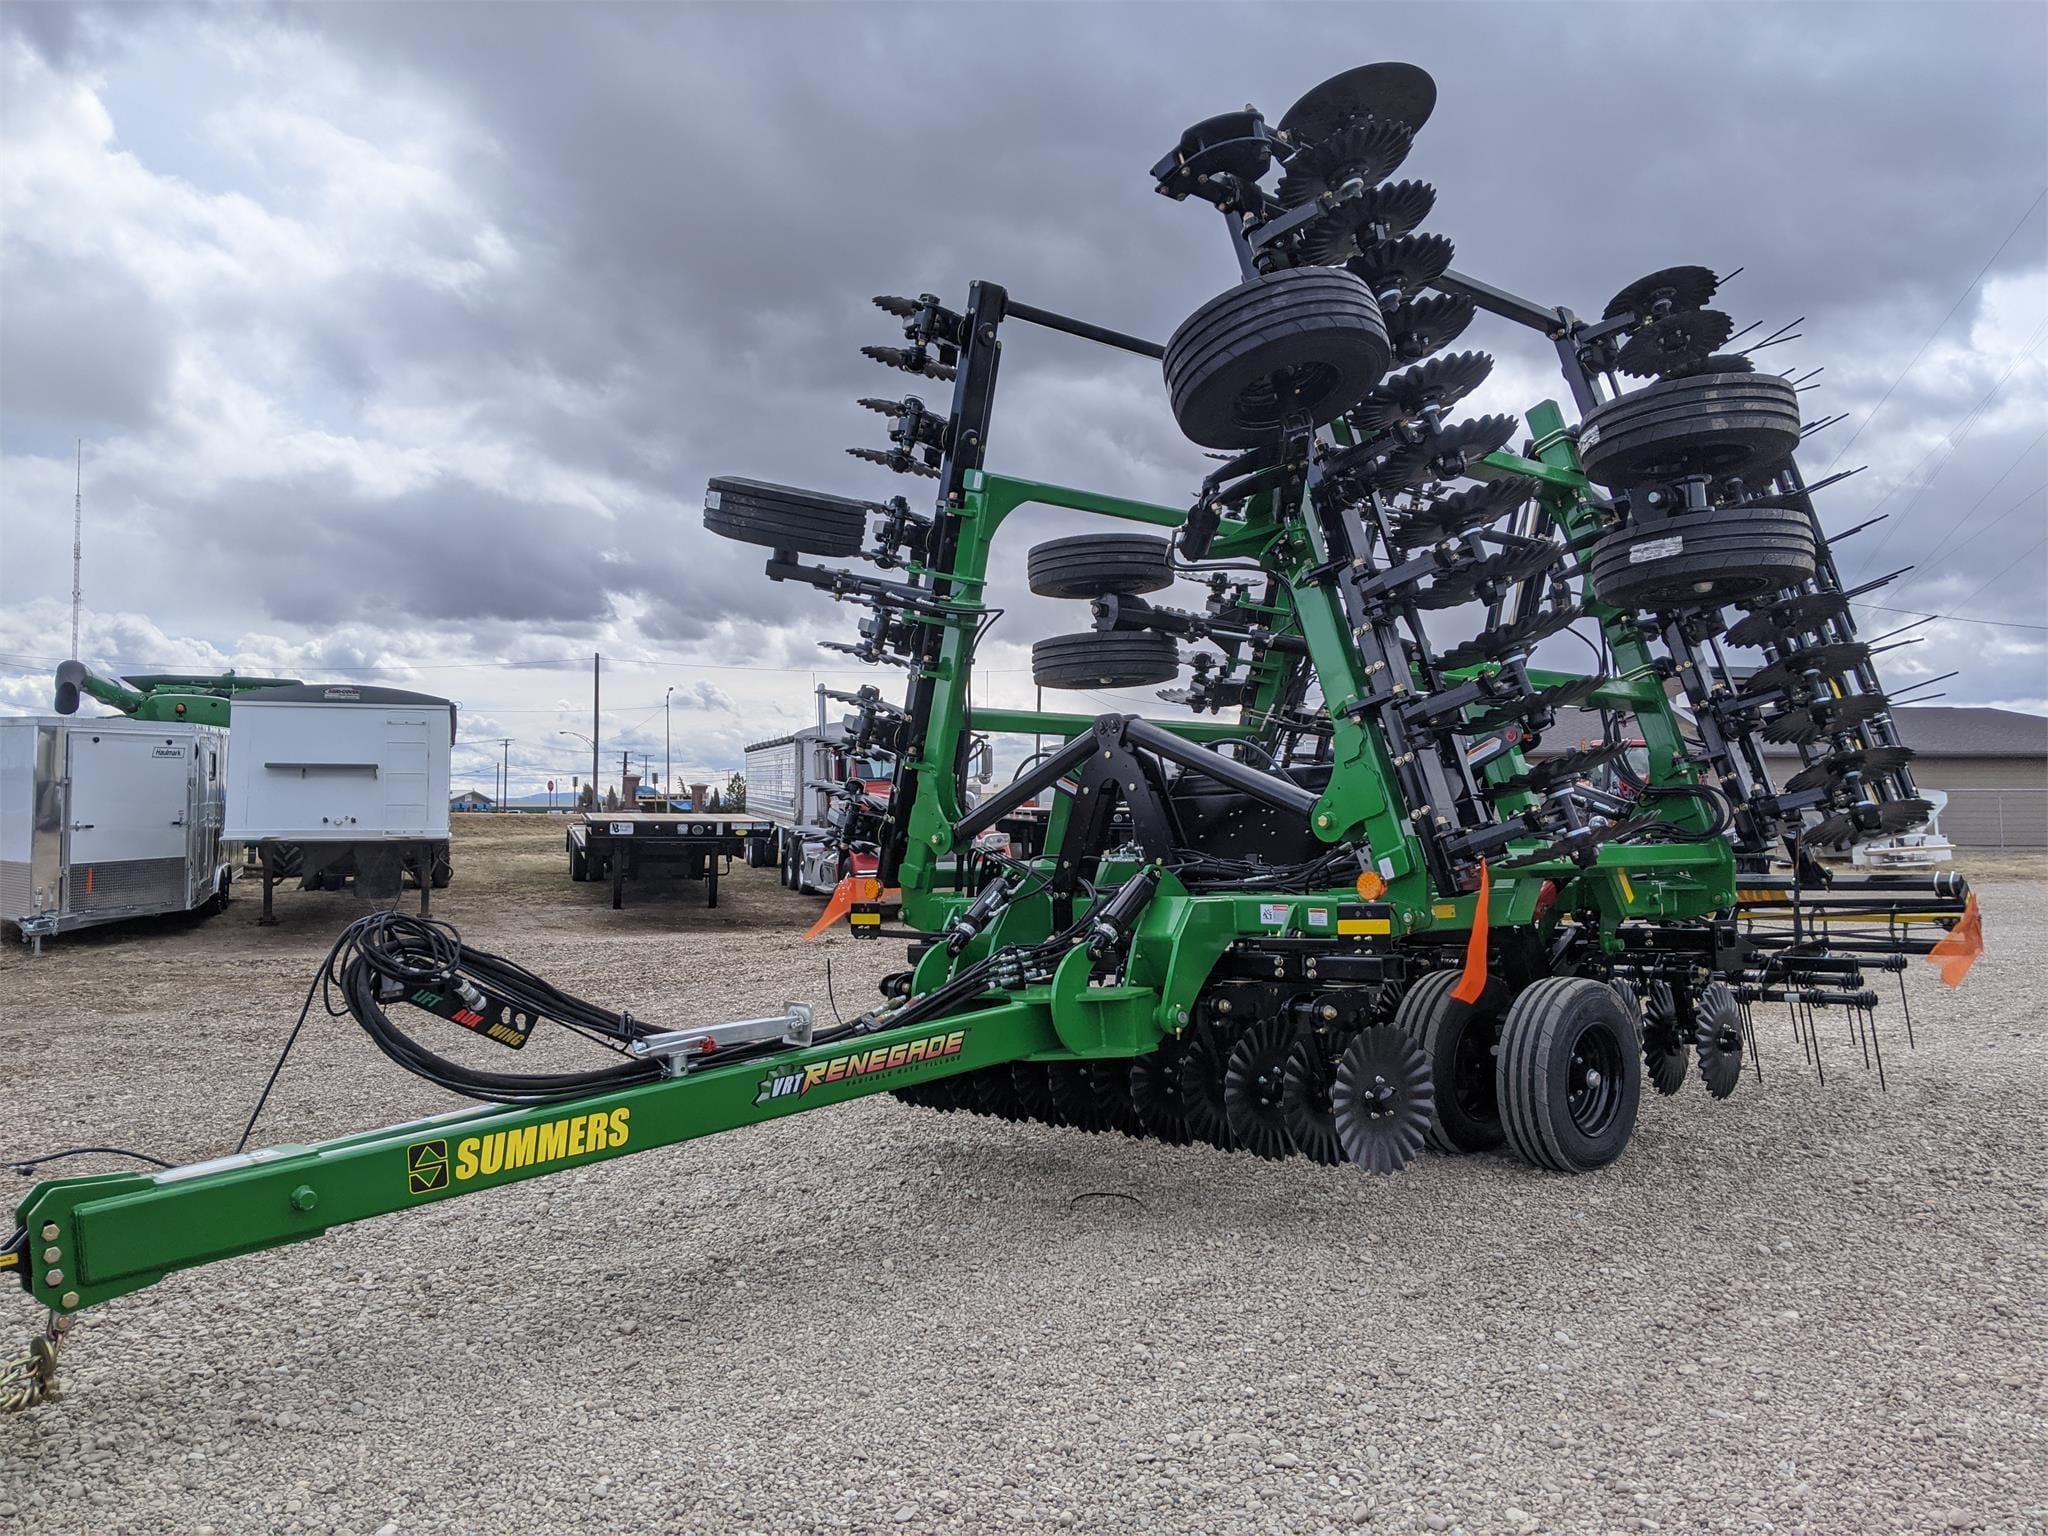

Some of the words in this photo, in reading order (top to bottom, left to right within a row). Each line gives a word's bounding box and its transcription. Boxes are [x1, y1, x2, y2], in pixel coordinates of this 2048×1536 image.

[155, 748, 181, 756] Haulmark
[410, 989, 444, 1007] LIFT
[451, 1008, 485, 1029] AUX
[487, 1022, 526, 1047] WING
[769, 1072, 804, 1099] VRT
[801, 1029, 966, 1098] RENEGADE
[846, 1069, 893, 1087] VARIABLE
[924, 1054, 962, 1069] TILLAGE
[455, 1107, 631, 1181] SUMMERS
